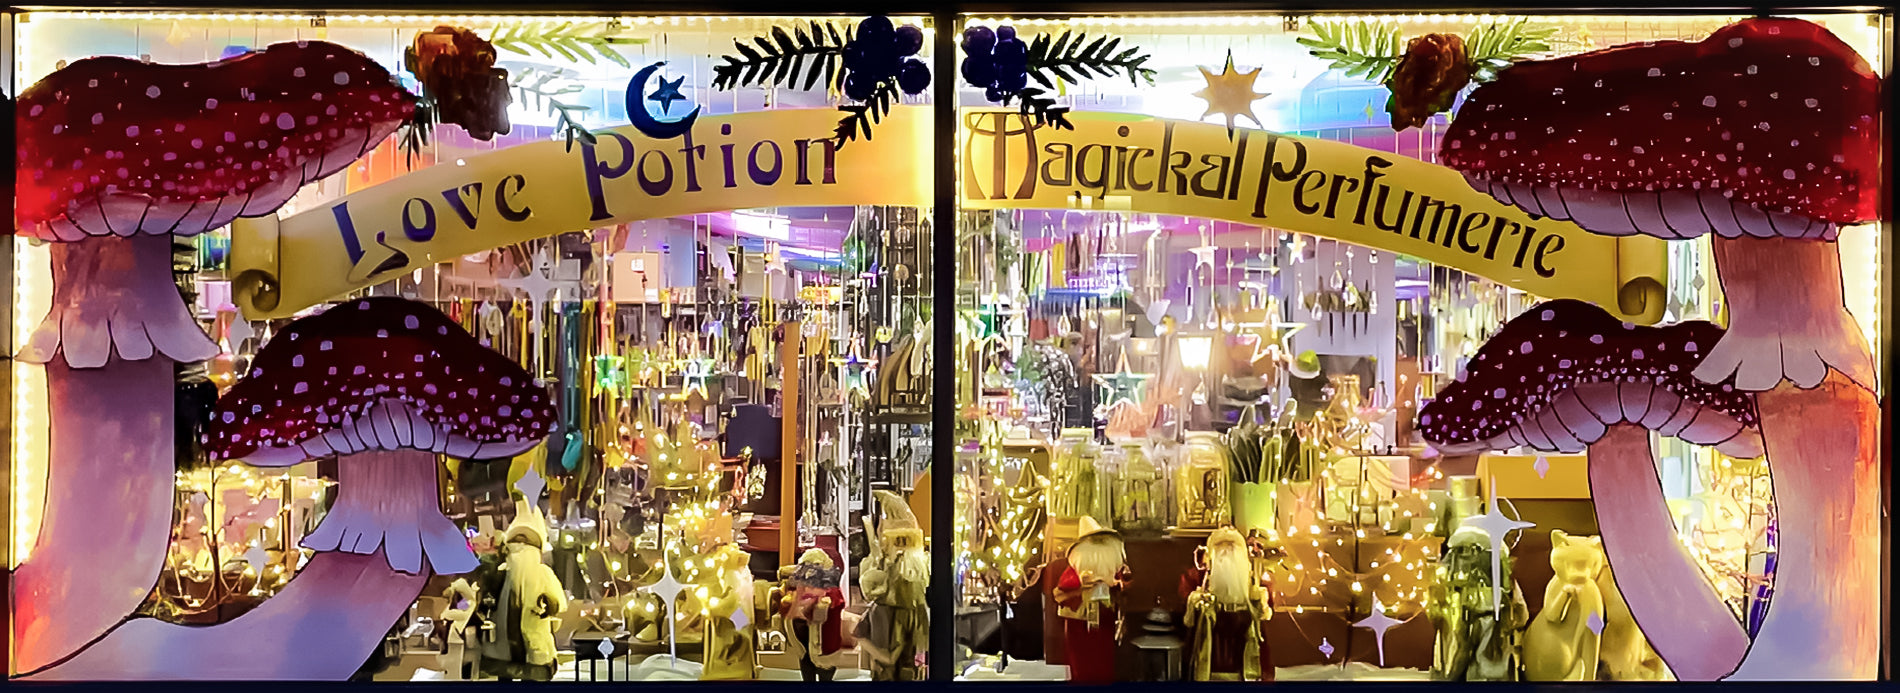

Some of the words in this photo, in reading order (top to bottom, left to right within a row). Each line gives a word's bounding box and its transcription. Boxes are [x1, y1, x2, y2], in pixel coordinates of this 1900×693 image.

[331, 173, 533, 283] Love
[582, 123, 839, 221] Potion
[964, 111, 1248, 200] Magickal
[1252, 134, 1566, 278] Perfumerie
